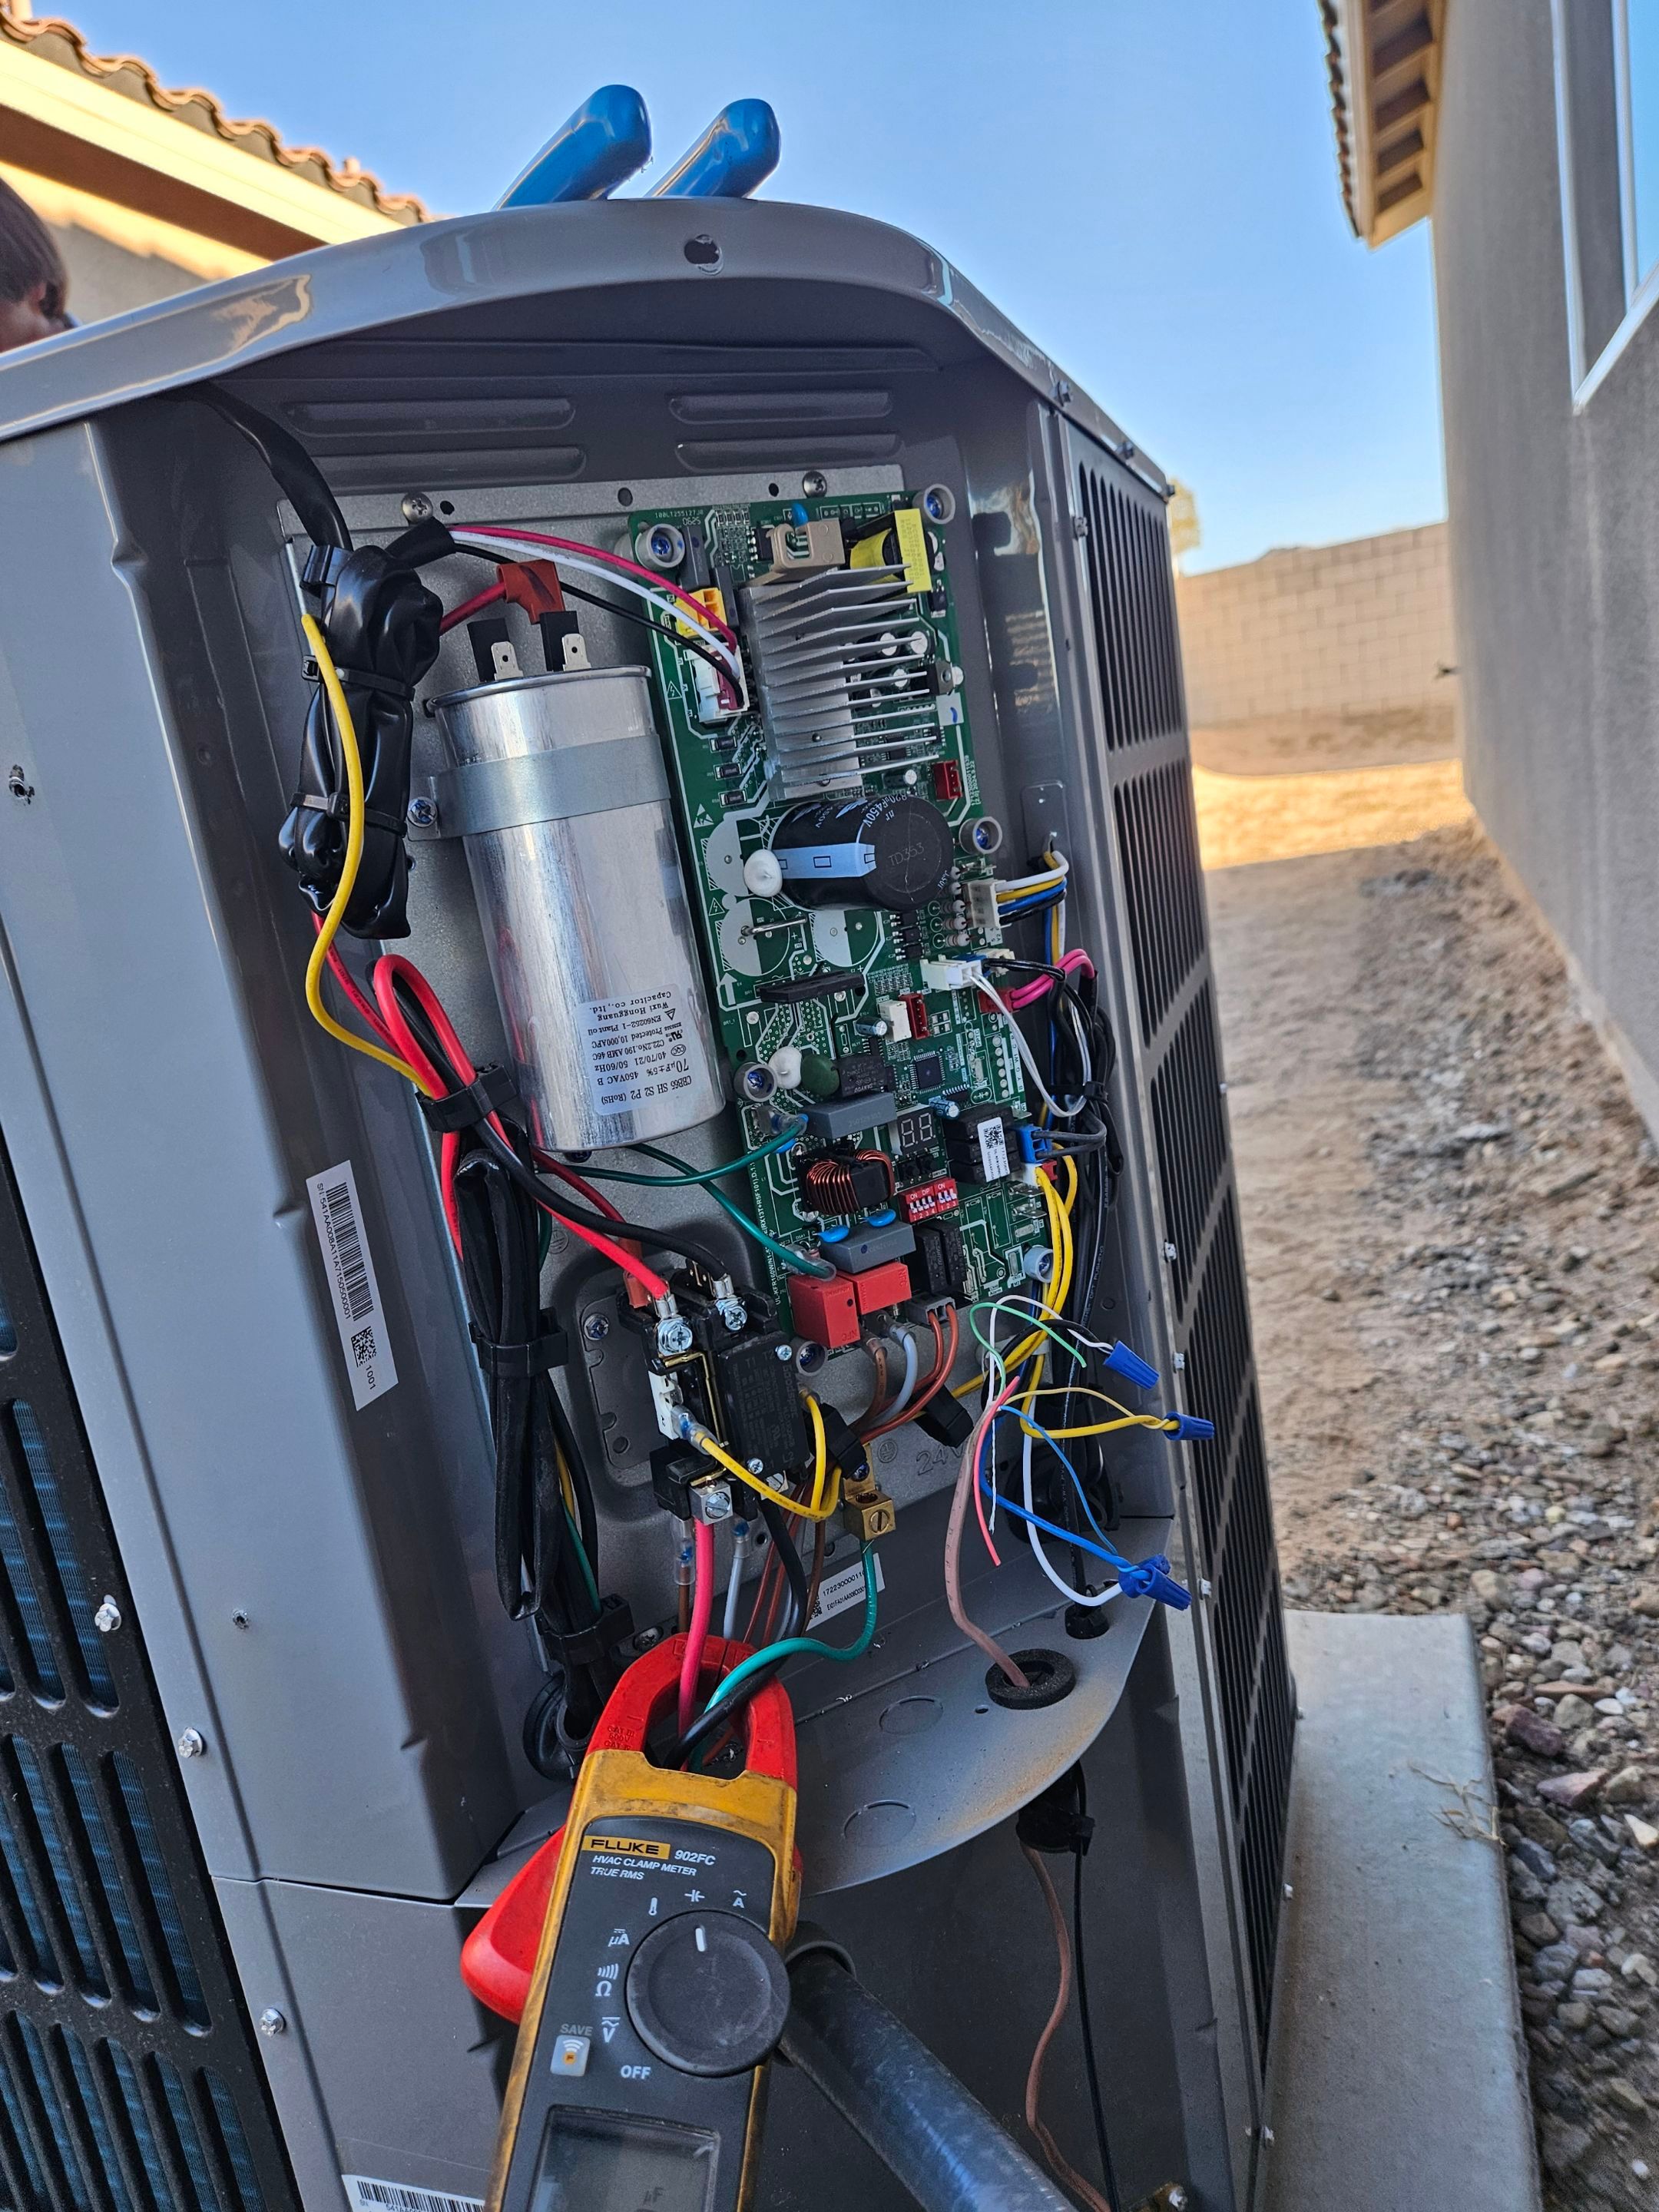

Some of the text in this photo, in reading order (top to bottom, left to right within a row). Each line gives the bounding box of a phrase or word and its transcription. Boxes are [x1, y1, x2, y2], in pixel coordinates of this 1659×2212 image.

[631, 991, 671, 1005] Capacitor
[598, 1002, 668, 1022] Wuxi Hongguang
[622, 1015, 661, 1029] EN60252-1
[591, 1028, 662, 1048] Protected 10,000AFC
[607, 1048, 622, 1058] AMB
[634, 1051, 666, 1065] 40/70/21
[594, 1060, 628, 1072] 50/60Hz
[608, 1071, 638, 1084] 450VAC
[601, 1075, 691, 1104] CBB65 SH S2 P2 (RoHS)
[366, 1365, 376, 1390] 1001
[591, 1838, 717, 1866] FLUKE 902FC
[592, 1855, 697, 1876] HVAC CLAMP METER
[590, 1866, 645, 1881] TRUE RMS
[560, 2024, 593, 2036] SAVE
[621, 2065, 651, 2079] OFF
